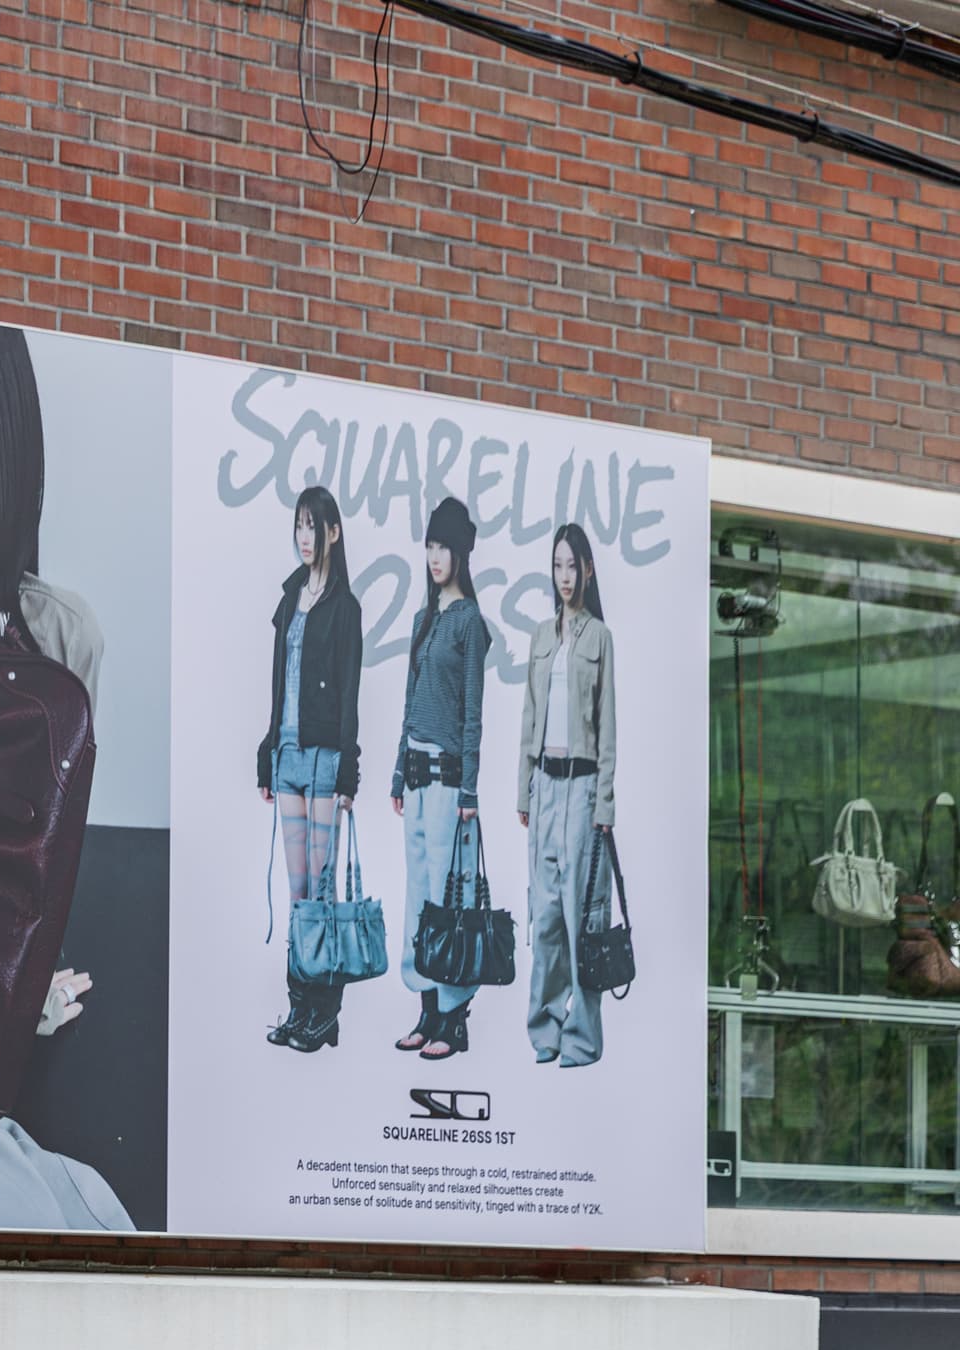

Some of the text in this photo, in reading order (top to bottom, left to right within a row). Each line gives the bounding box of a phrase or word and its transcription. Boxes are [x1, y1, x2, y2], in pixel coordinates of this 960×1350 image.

[383, 1126, 516, 1145] SQUARELINE 26SS 1ST
[297, 1159, 596, 1182] A decadent tension that seeps through a cold, restrained attitude.
[332, 1177, 564, 1197] Unforced sensuality and relaxed silhouettes create
[289, 1194, 604, 1215] an urban sense of solitude and sensitivity, tinged with a trace of Y2K.
